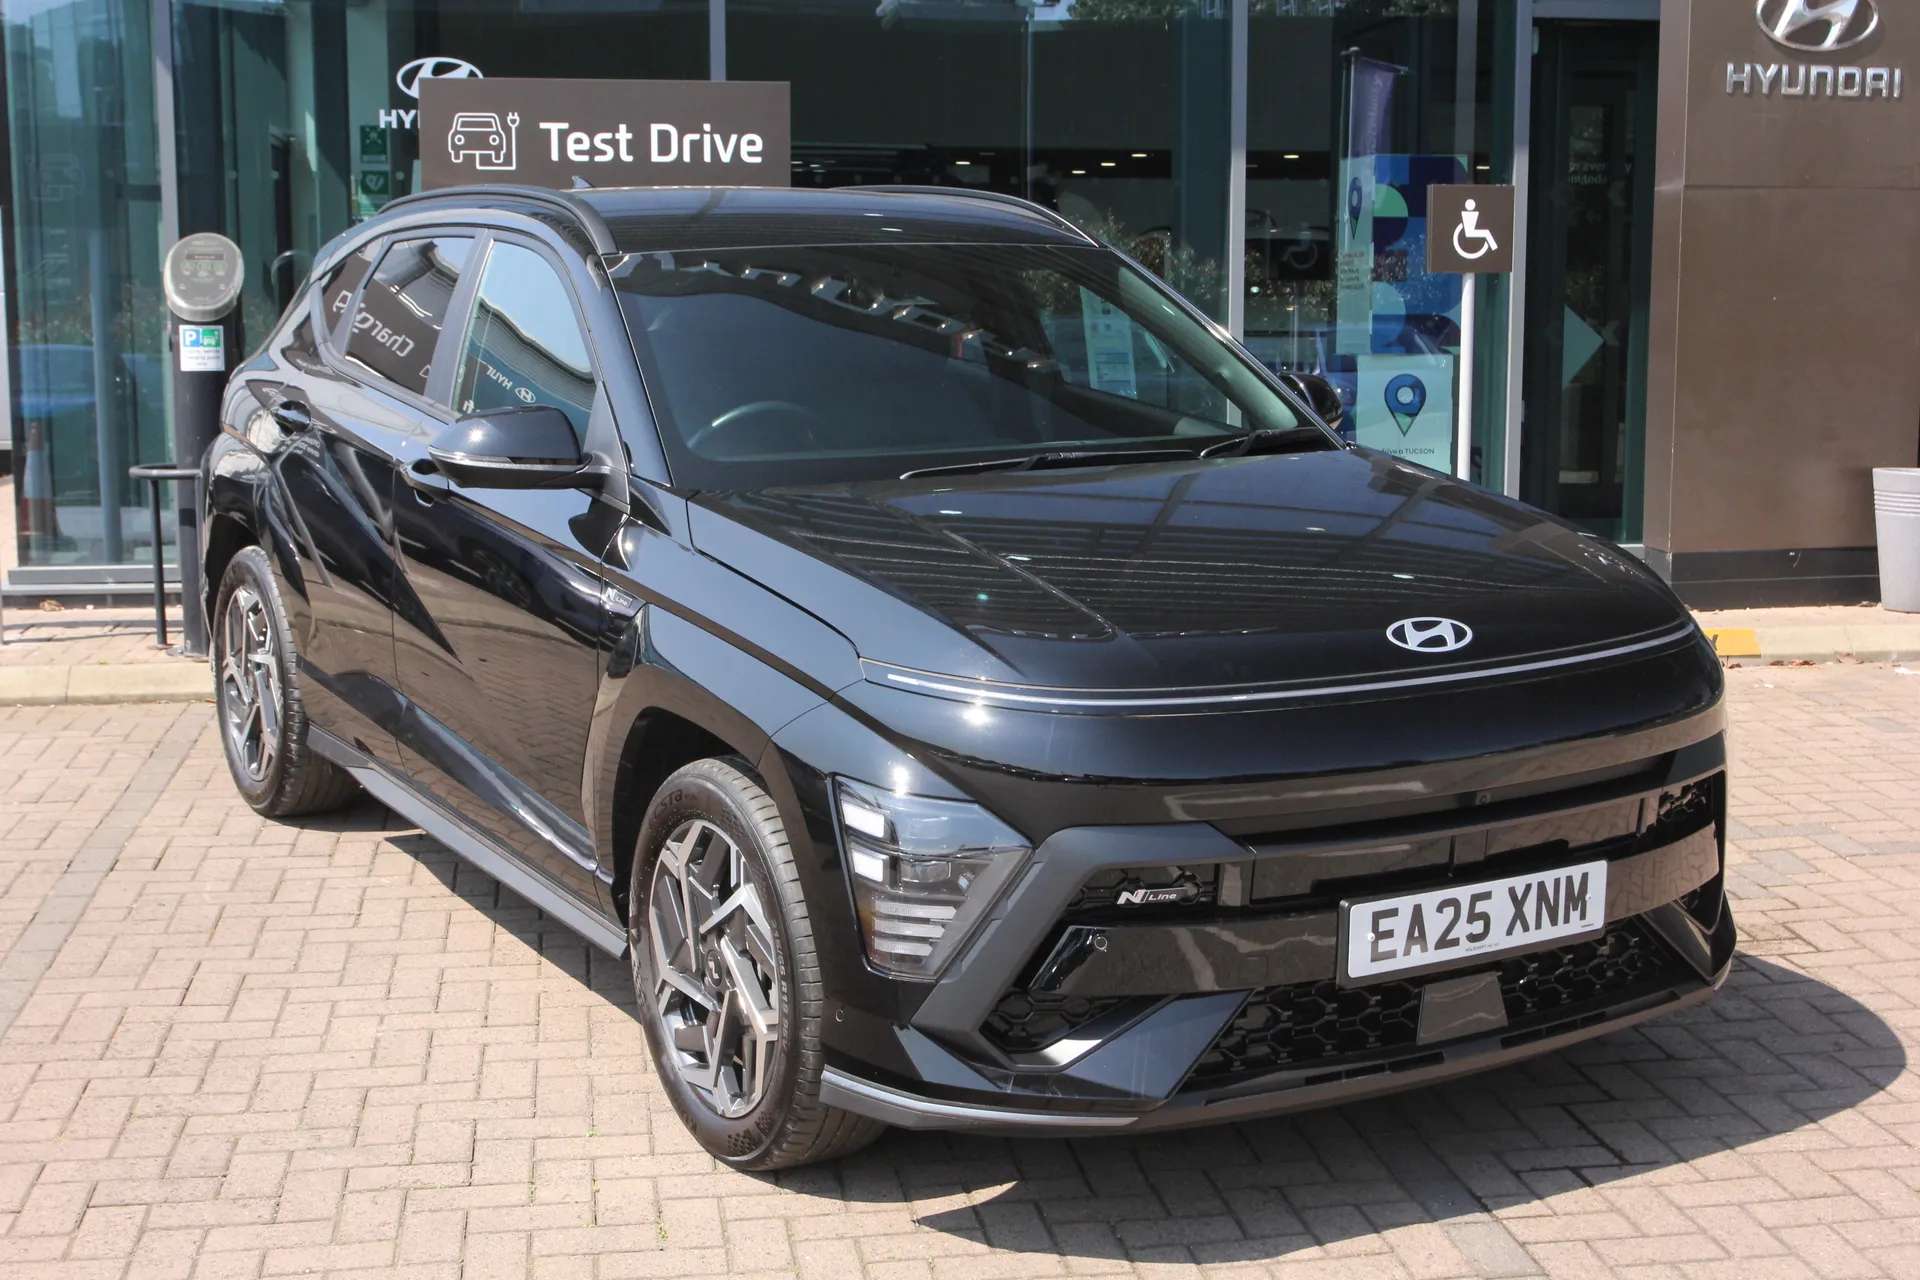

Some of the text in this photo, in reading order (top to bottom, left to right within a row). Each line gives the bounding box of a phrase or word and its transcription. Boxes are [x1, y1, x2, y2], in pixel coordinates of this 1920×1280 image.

[1726, 62, 1902, 98] HYUNDAI
[539, 122, 764, 163] Test Drive
[1405, 447, 1435, 455] TUCSON
[1370, 871, 1589, 963] EA25 XNM
